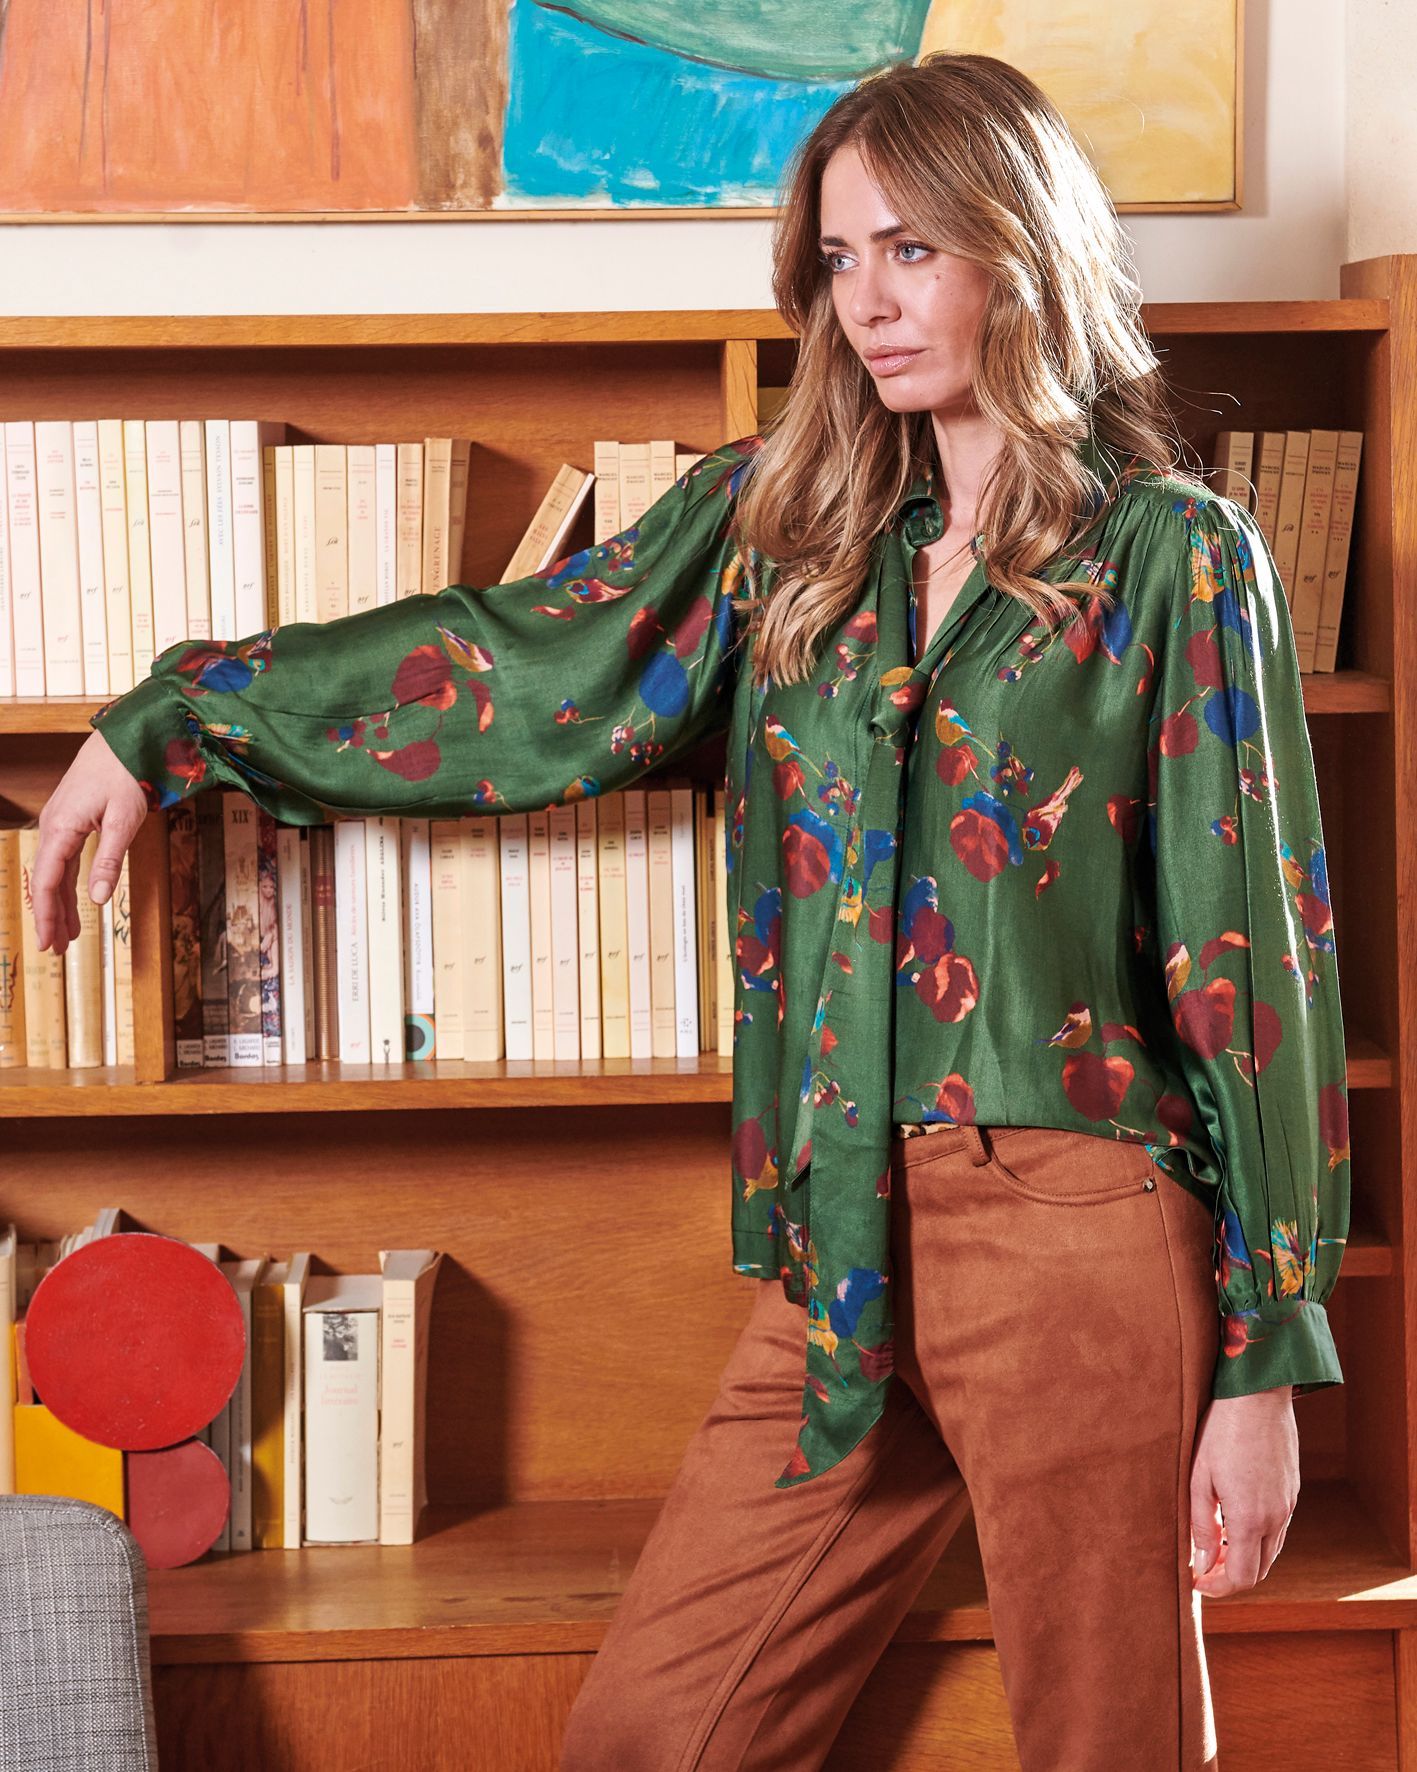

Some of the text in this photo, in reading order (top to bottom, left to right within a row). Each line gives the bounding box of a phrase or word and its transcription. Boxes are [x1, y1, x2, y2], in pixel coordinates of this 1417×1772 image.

[349, 942, 360, 1003] ERRI DE LUCA
[234, 1052, 260, 1061] Bordas
[324, 1384, 359, 1395] Journal
